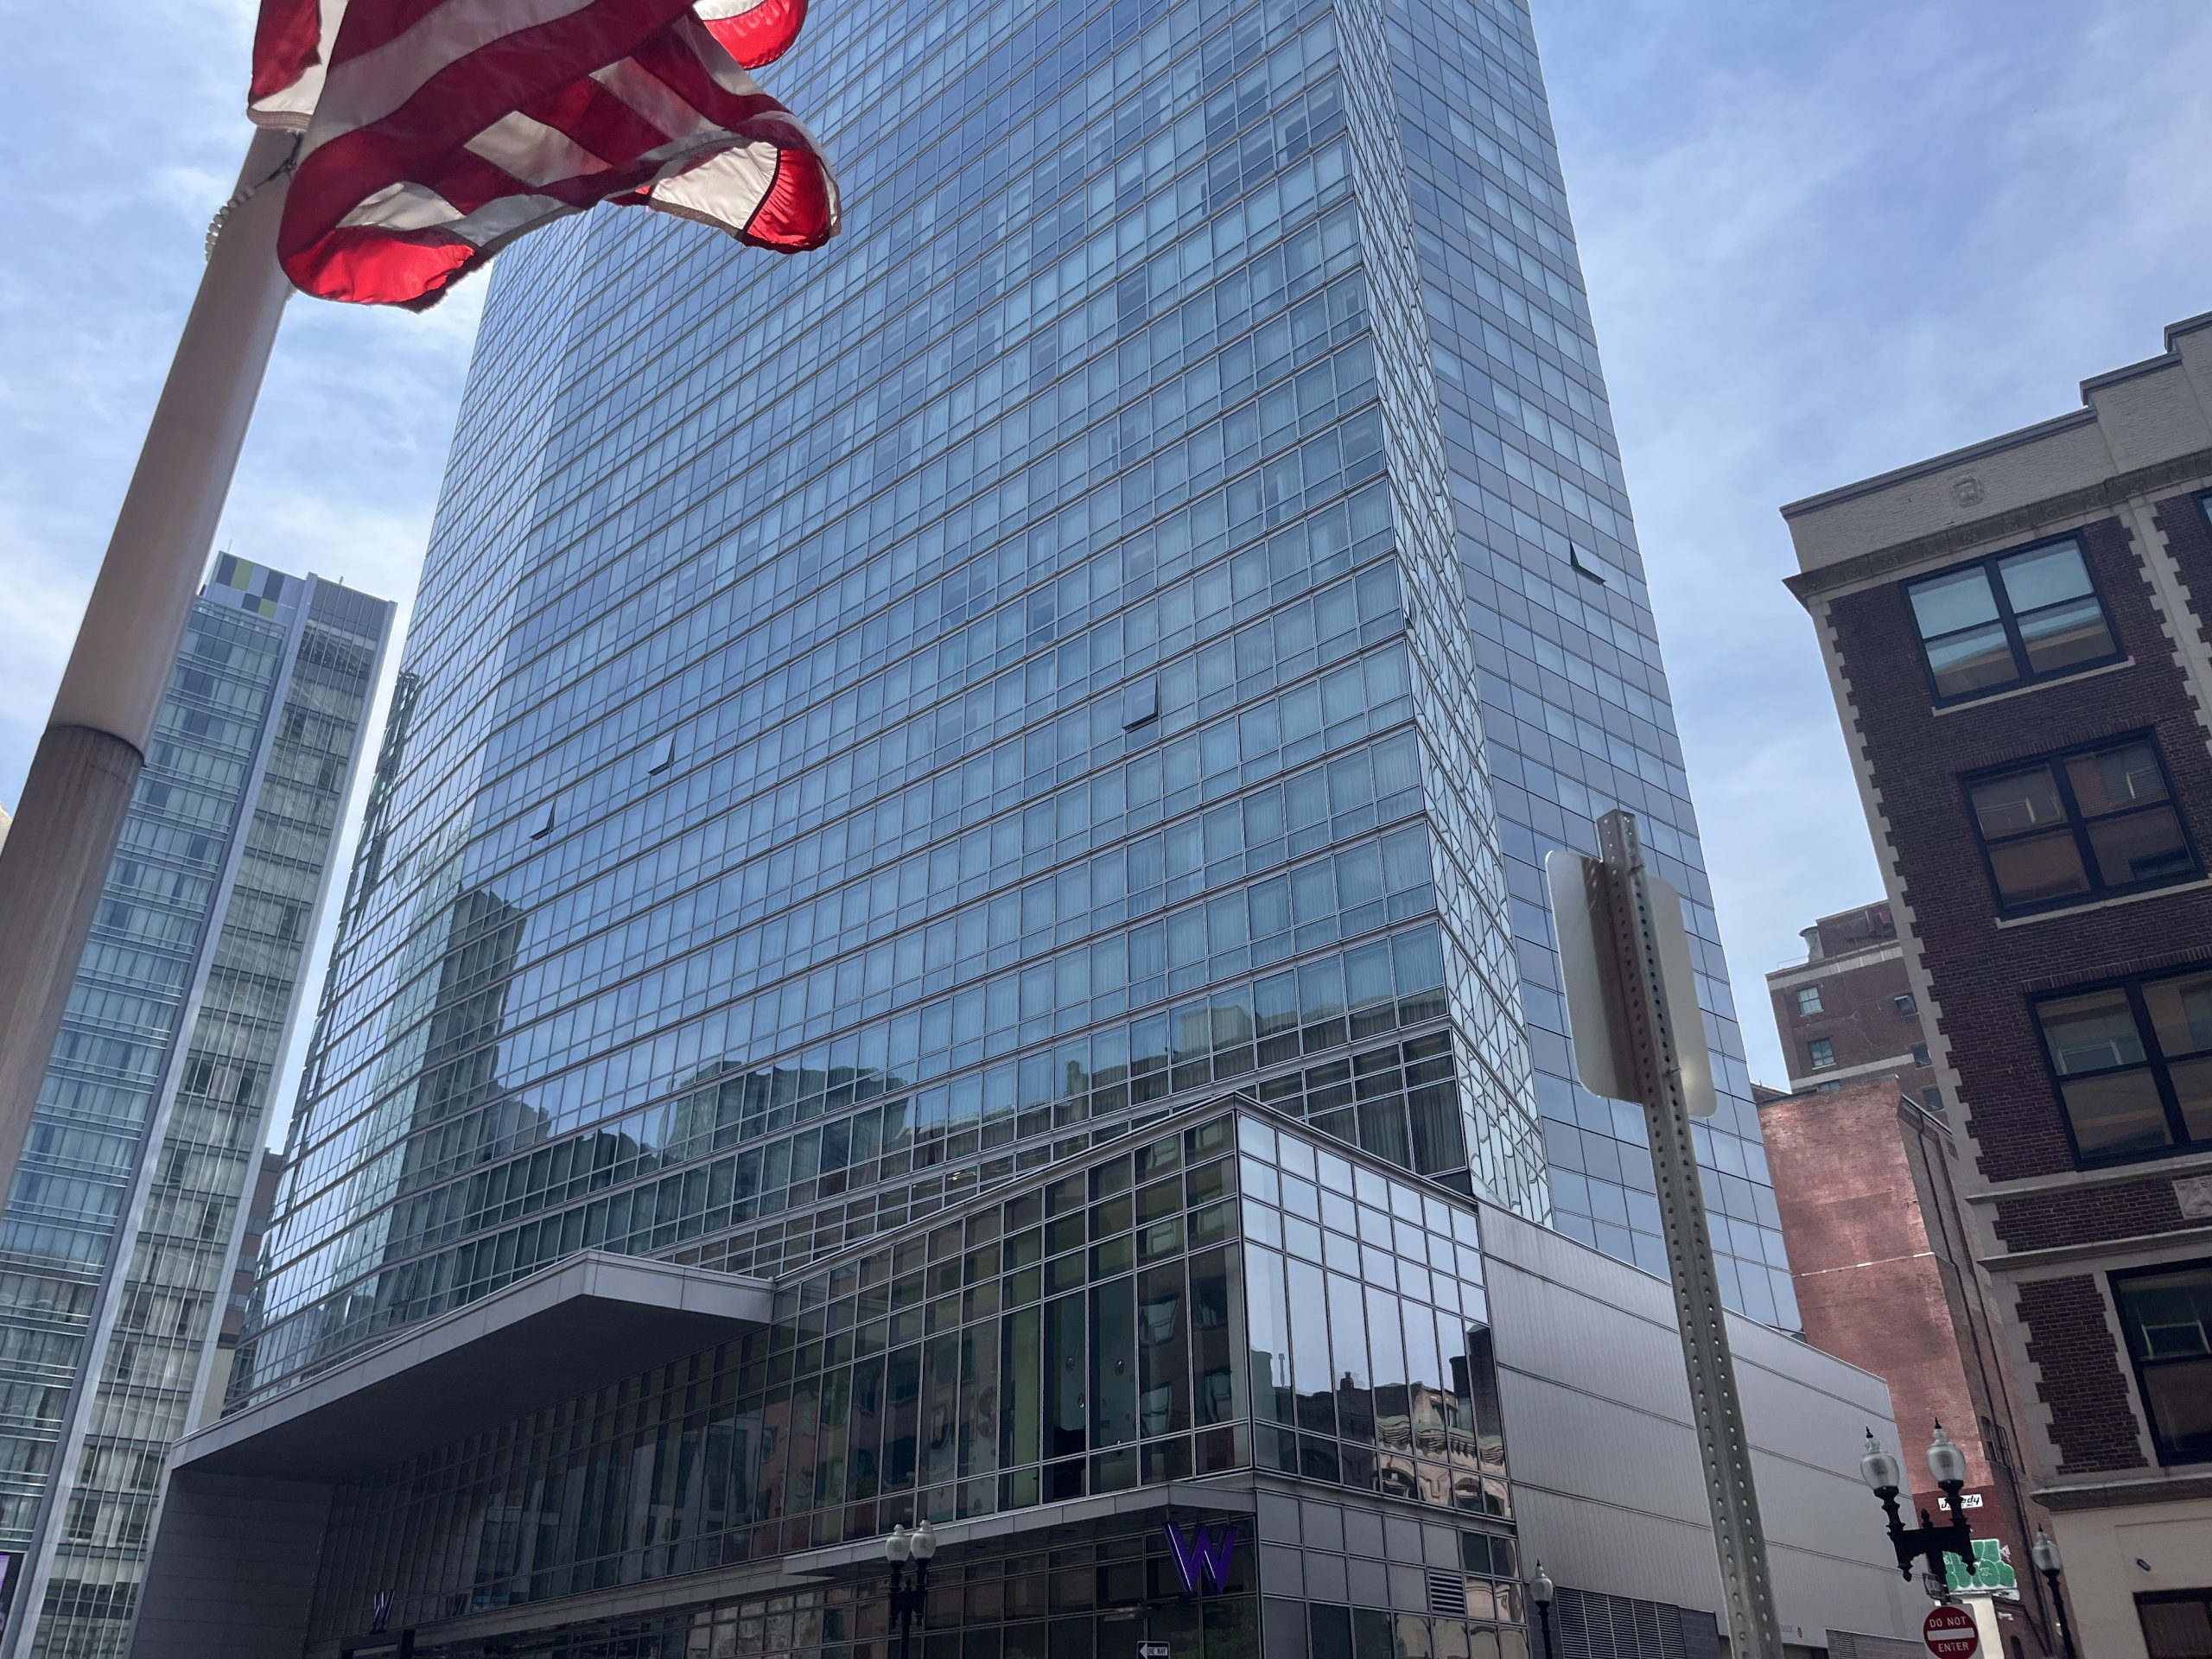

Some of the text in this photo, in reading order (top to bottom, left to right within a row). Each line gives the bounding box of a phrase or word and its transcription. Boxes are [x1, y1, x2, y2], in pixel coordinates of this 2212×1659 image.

[1161, 1521, 1237, 1595] W
[372, 1590, 395, 1628] W
[1929, 1616, 1966, 1628] DO NOT
[1938, 1642, 1969, 1653] ENTER
